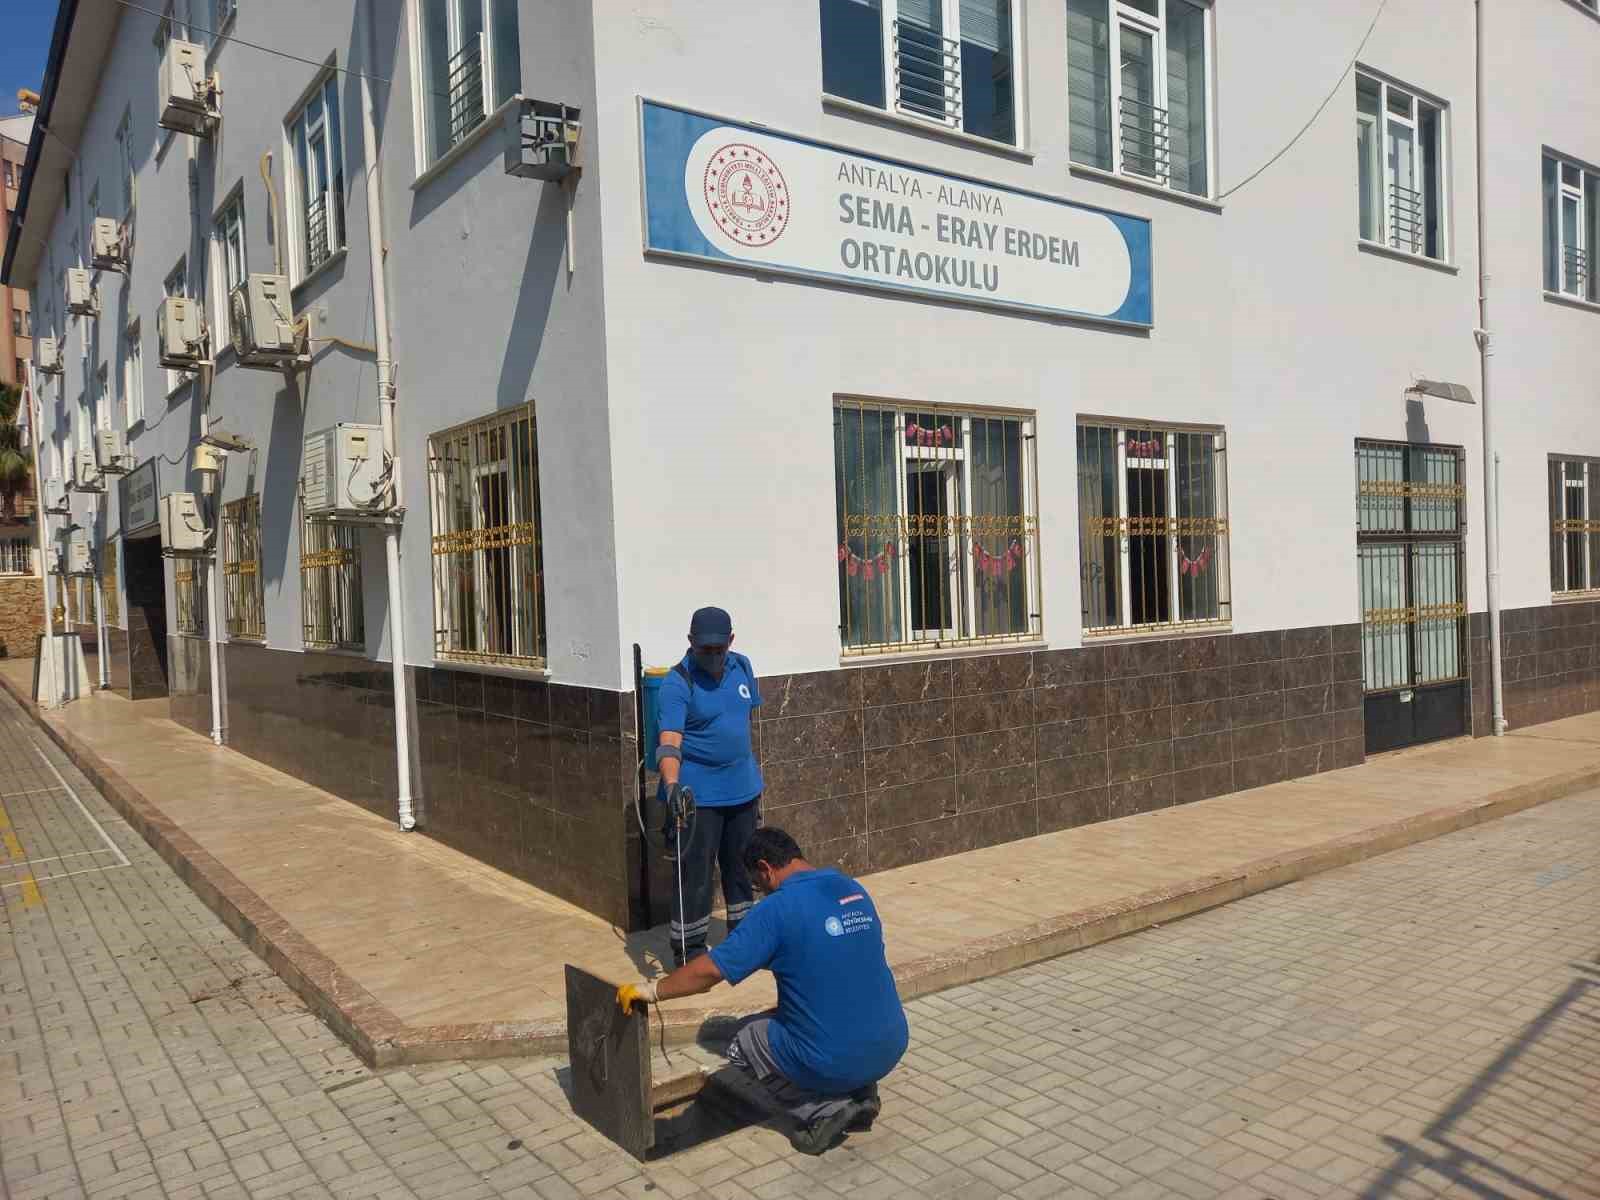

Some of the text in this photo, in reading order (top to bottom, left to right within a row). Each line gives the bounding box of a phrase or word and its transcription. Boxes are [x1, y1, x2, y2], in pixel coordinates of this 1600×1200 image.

[838, 162, 922, 199] ANTALYA
[937, 184, 1003, 216] ALANYA
[839, 193, 914, 236] SEMA
[936, 213, 998, 251] ERAY
[1004, 227, 1080, 268] ERDEM
[840, 238, 999, 292] ORTAOKULU
